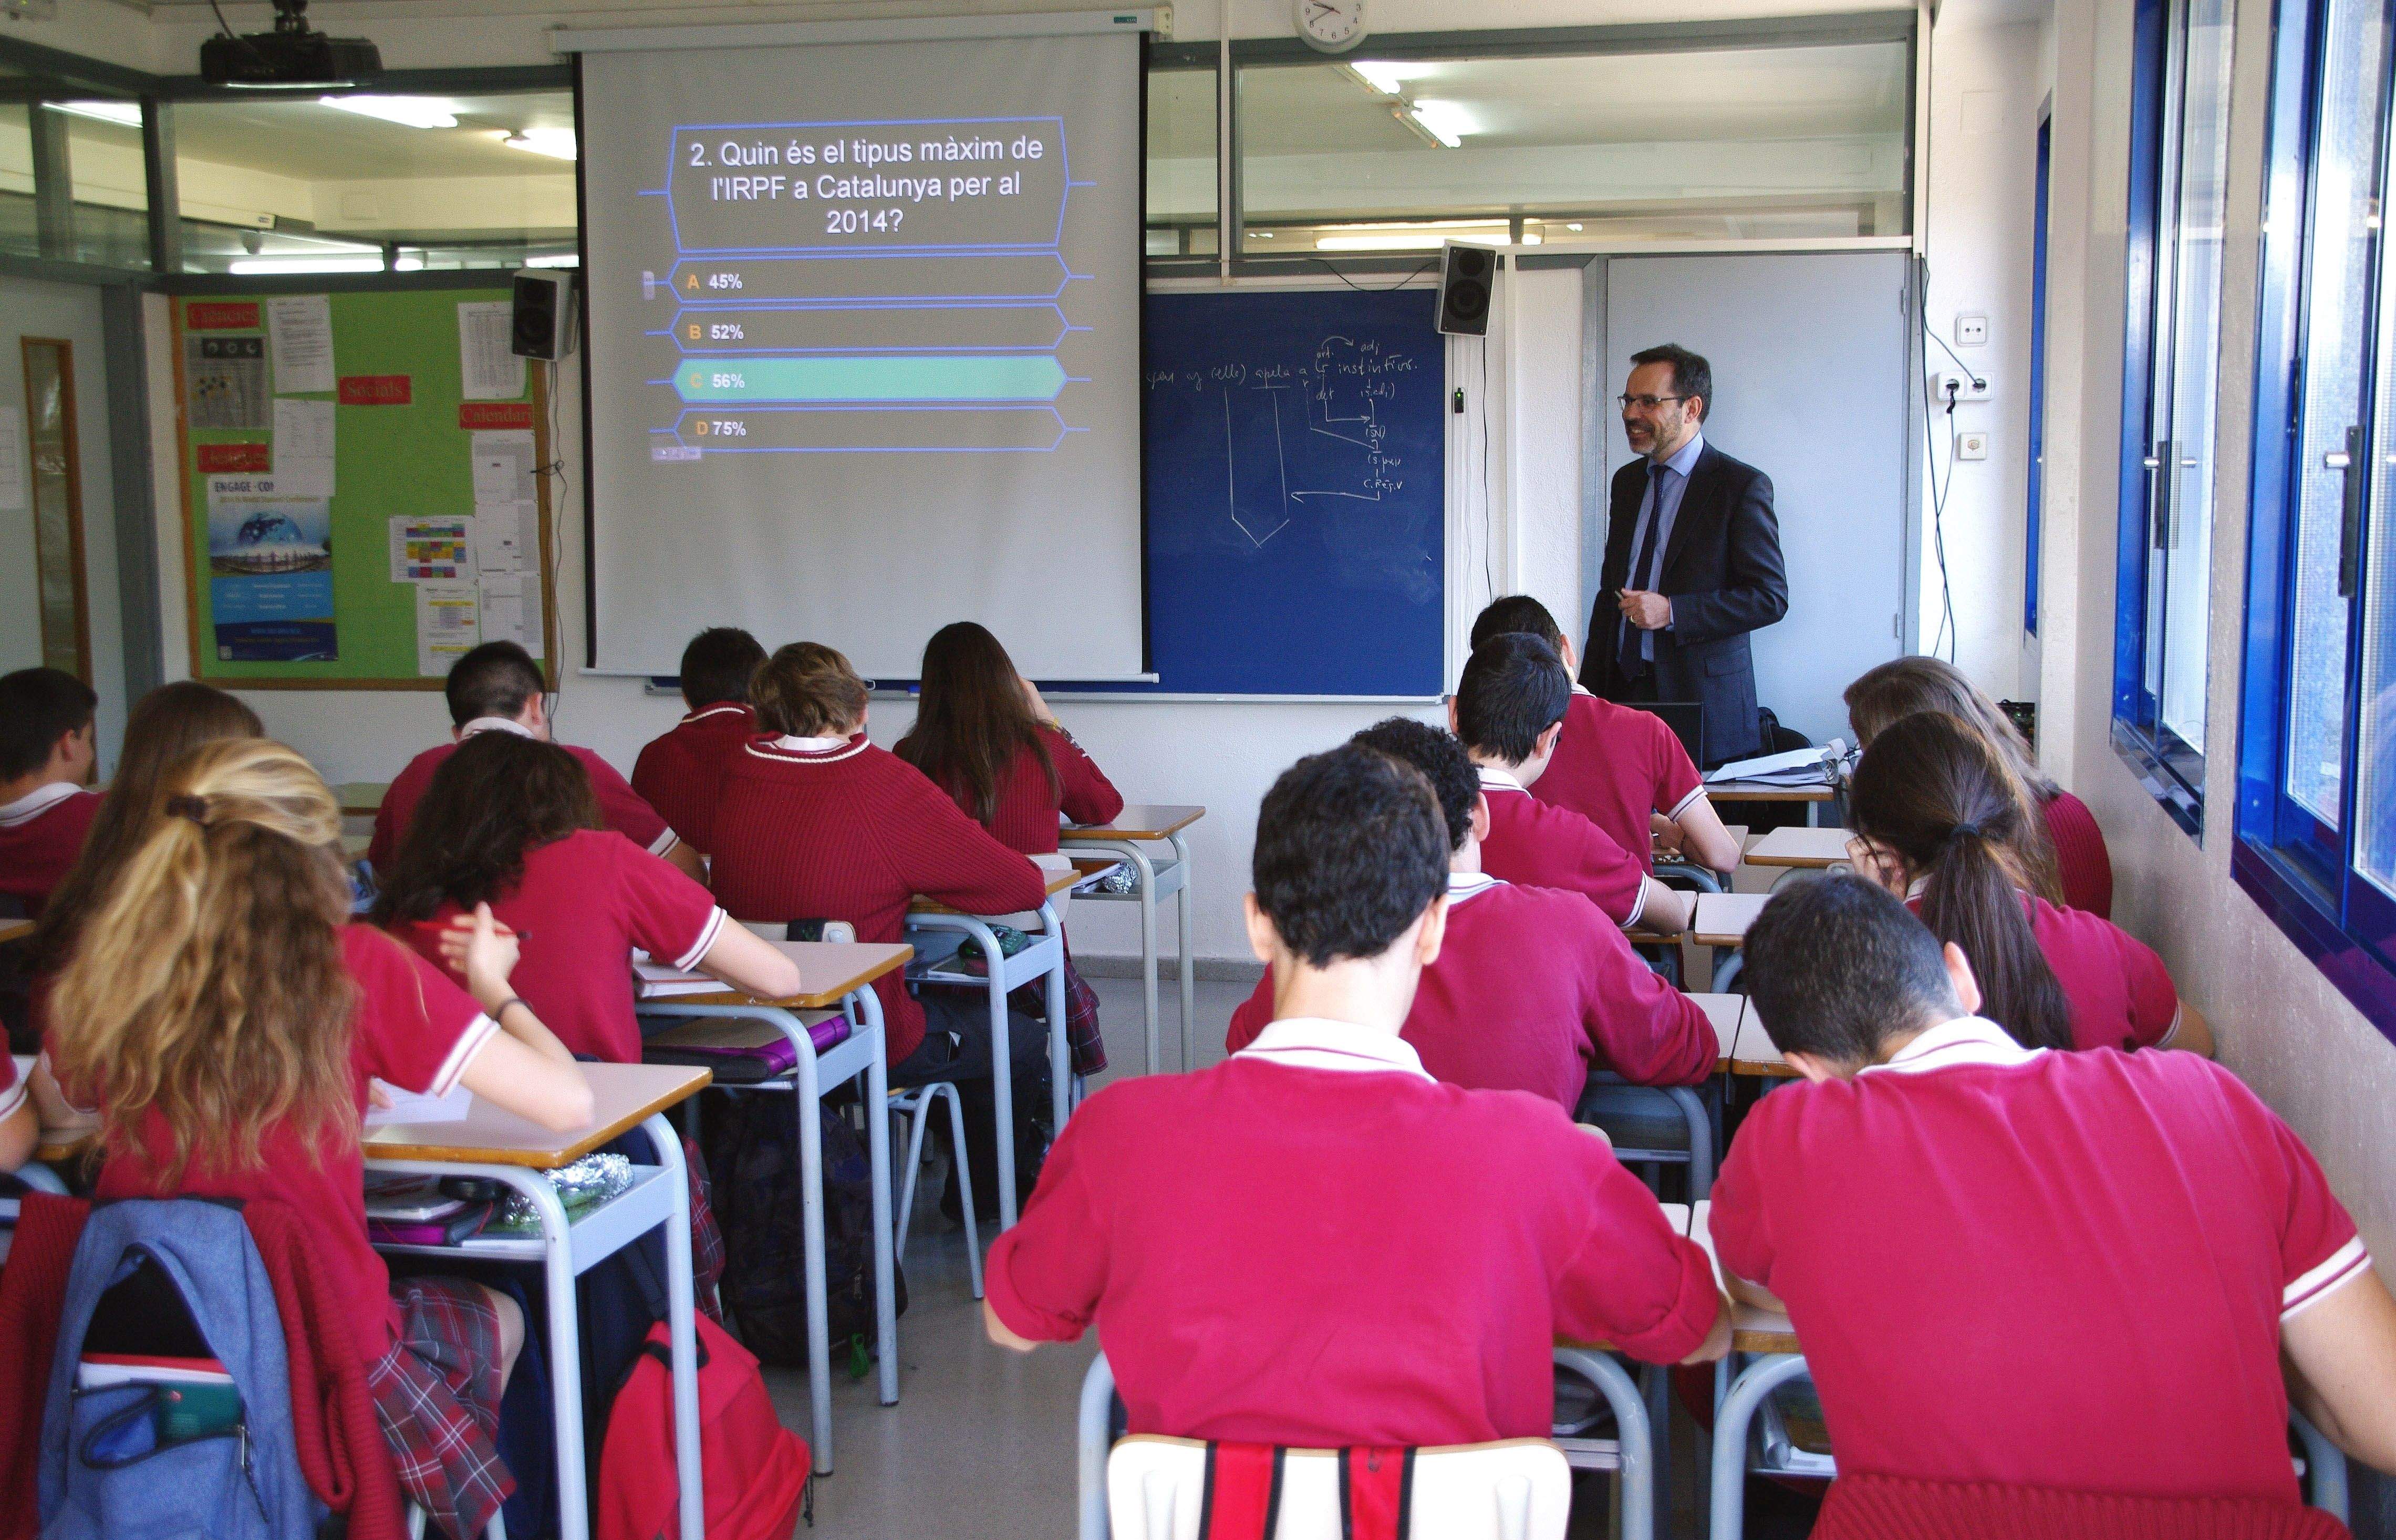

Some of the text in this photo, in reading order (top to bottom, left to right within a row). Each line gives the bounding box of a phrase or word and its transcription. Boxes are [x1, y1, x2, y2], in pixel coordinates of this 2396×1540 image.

[689, 134, 1043, 169] 2. Quin és el tipus màxim de
[712, 171, 1020, 203] l'IRPF a Catalunya per al
[826, 209, 904, 234] 2014?
[687, 273, 743, 289] A 45%
[689, 324, 744, 340] B 52%
[690, 372, 745, 388] C 56%
[696, 421, 747, 436] D 75%
[214, 481, 251, 493] ENGAGE
